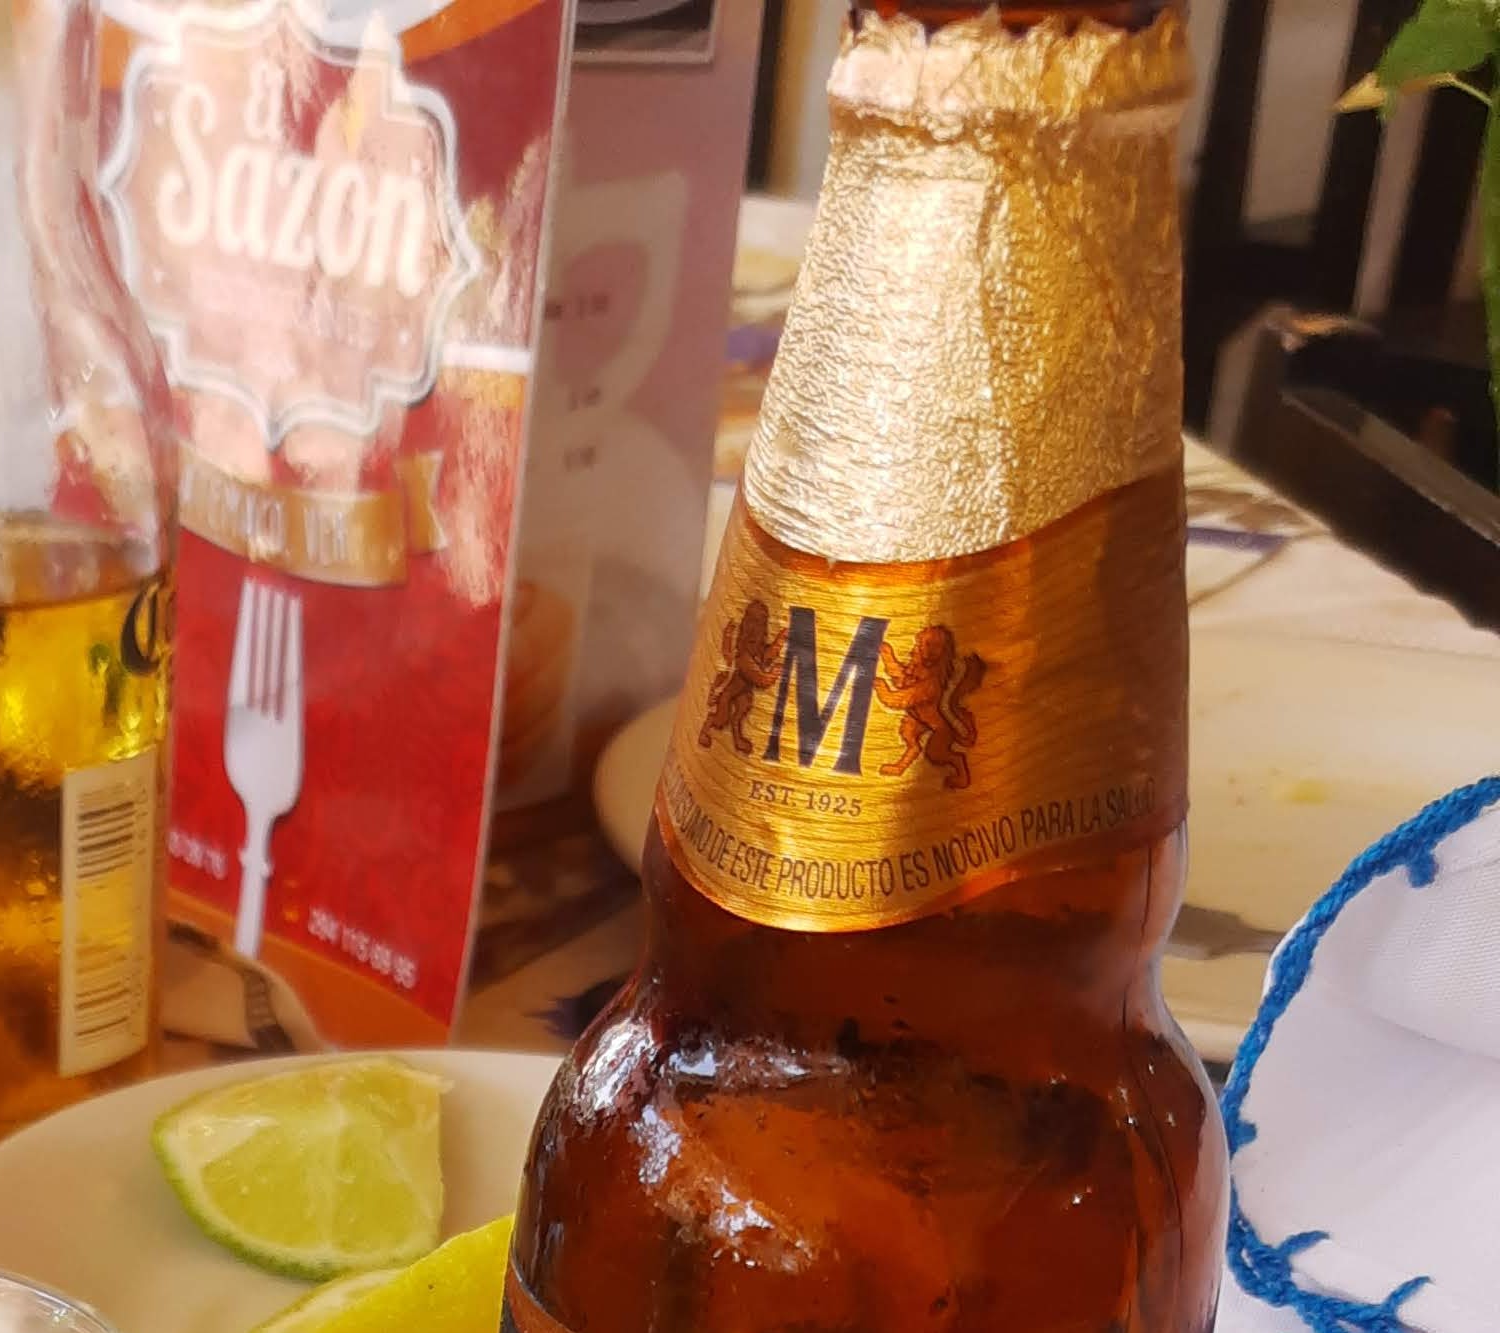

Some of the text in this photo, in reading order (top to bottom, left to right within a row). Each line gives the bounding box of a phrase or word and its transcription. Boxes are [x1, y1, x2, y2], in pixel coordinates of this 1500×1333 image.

[762, 605, 891, 777] M
[708, 828, 736, 870] DE
[730, 841, 778, 891] ESTE
[777, 856, 895, 901] PRODUCTO
[901, 849, 930, 892] ES
[932, 814, 1017, 882] NOCIVO
[1020, 797, 1075, 847] PARA
[1079, 792, 1101, 835] LA
[749, 779, 863, 818] EST. 1925
